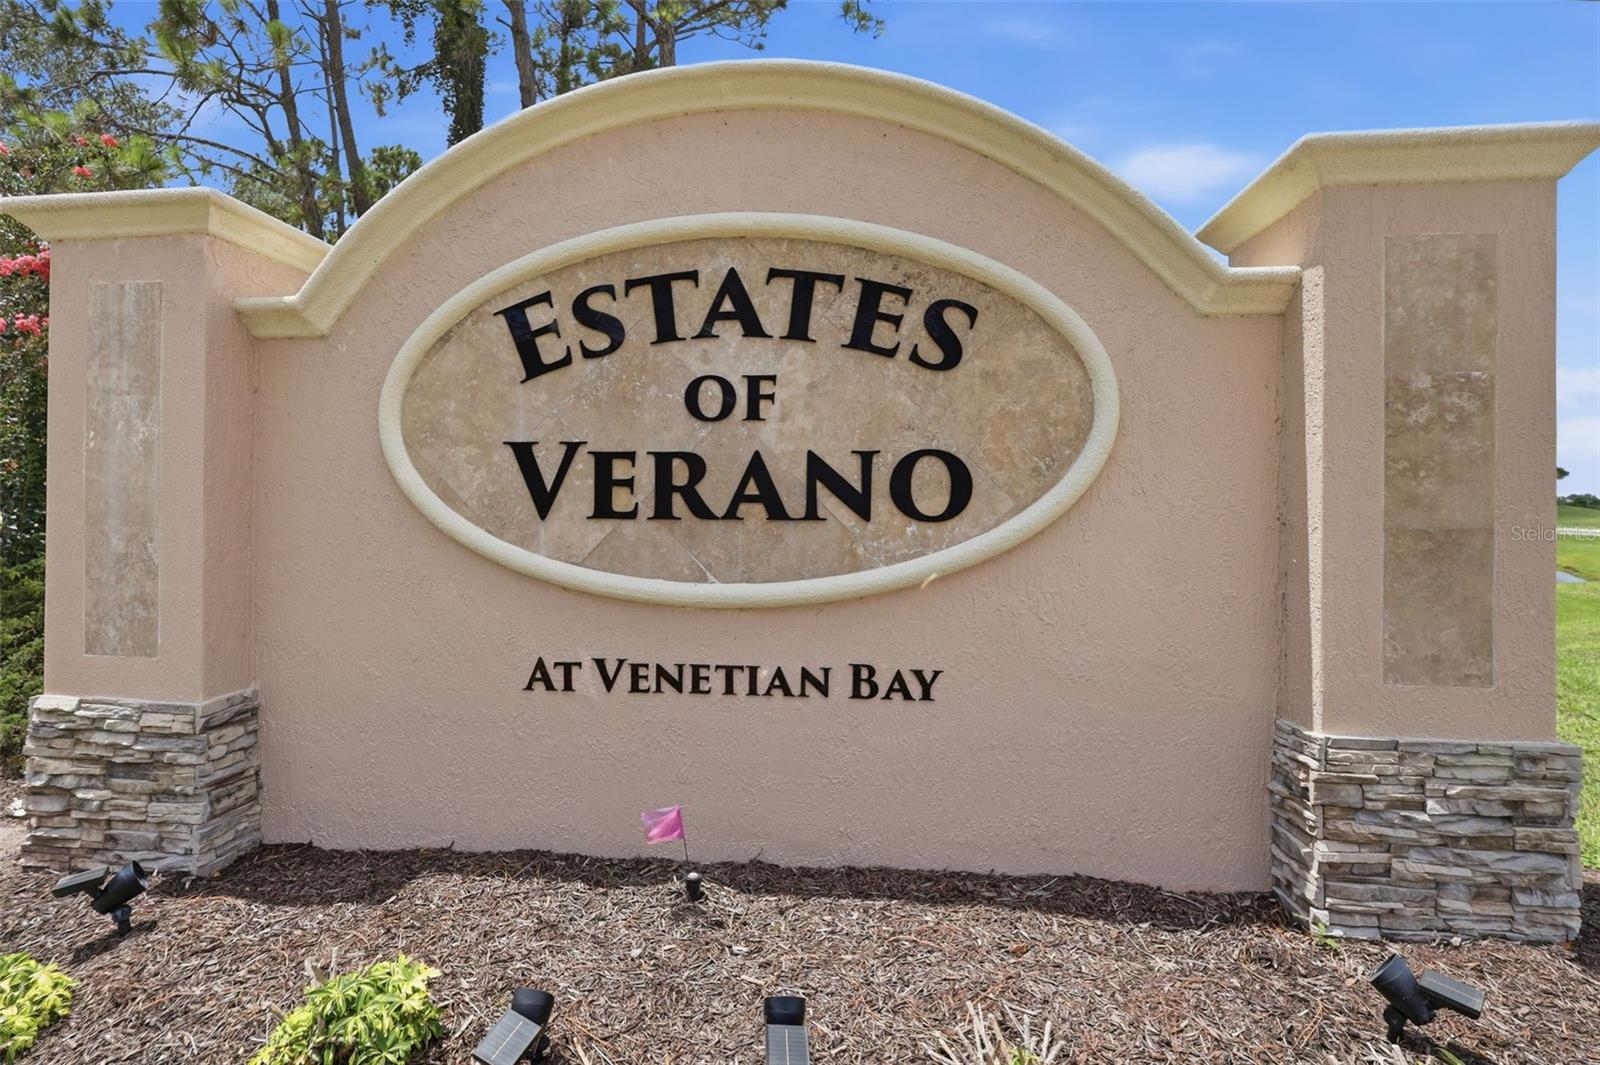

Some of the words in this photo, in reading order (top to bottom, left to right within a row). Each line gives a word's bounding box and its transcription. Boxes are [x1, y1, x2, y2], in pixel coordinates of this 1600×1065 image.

[493, 267, 979, 383] ESTATES
[685, 375, 777, 422] OF
[502, 441, 974, 522] VERANO
[523, 657, 583, 692] AT
[592, 658, 832, 699] VENETIAN
[848, 664, 944, 702] BAY
